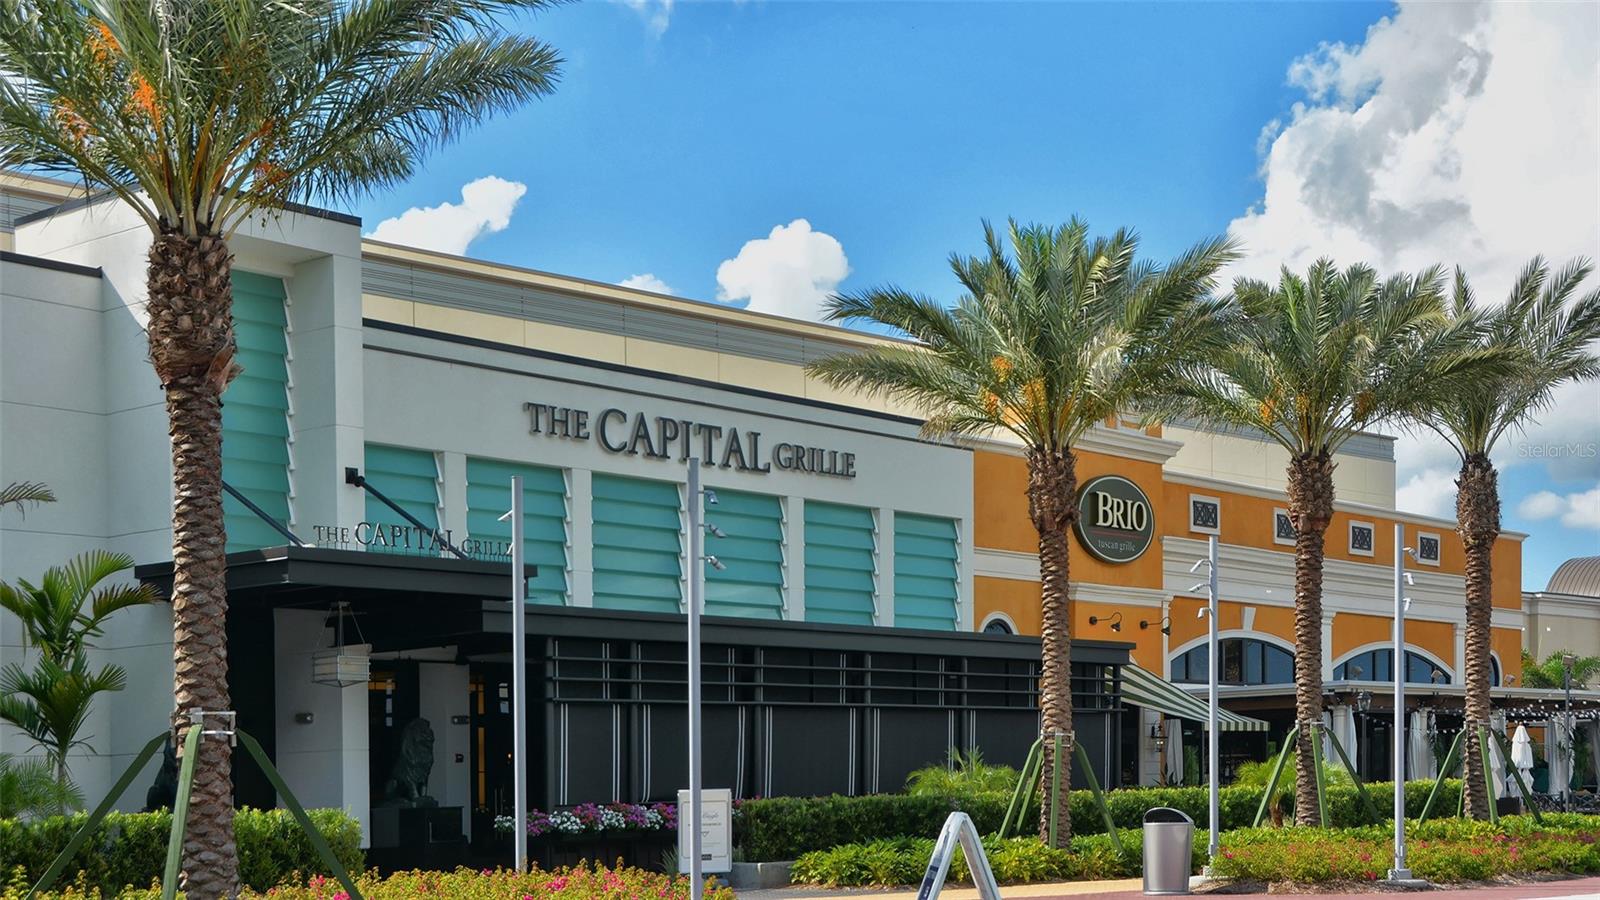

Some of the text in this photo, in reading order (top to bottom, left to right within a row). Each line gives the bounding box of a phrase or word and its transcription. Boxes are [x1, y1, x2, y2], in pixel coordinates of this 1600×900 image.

[524, 401, 857, 478] THE CAPITAL GRILLE
[312, 525, 350, 544] THE
[354, 521, 459, 551] CAPITAL
